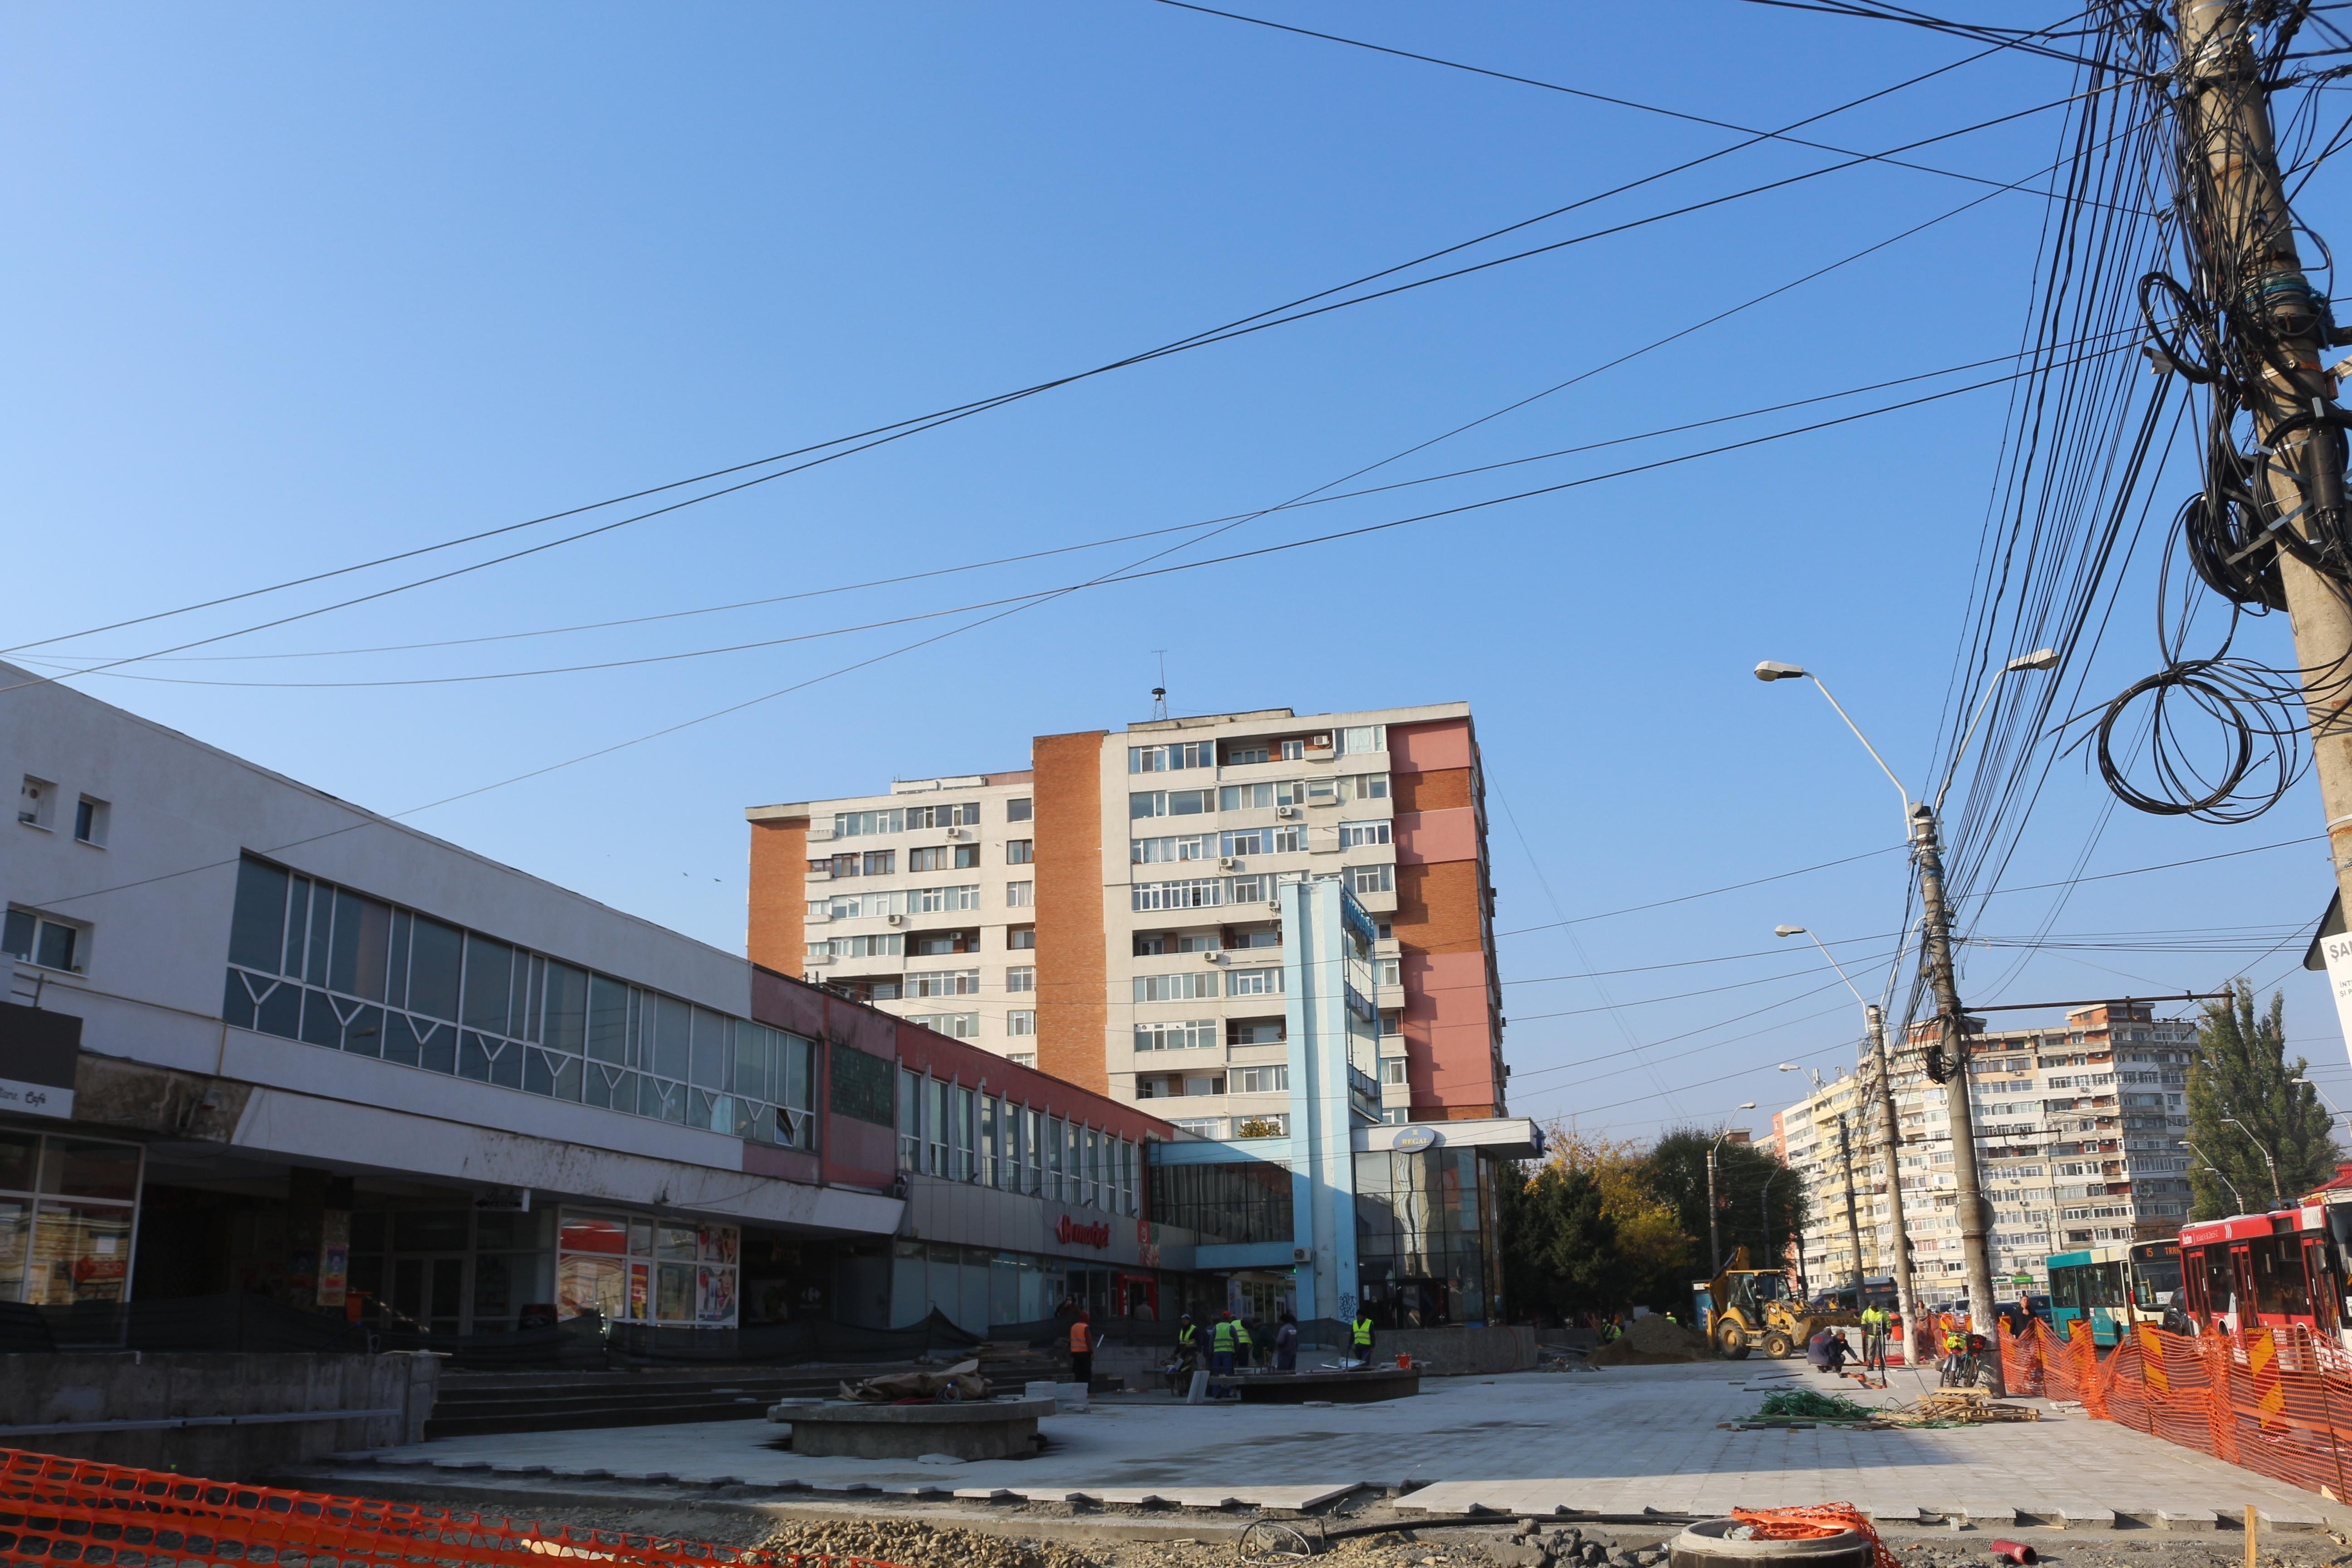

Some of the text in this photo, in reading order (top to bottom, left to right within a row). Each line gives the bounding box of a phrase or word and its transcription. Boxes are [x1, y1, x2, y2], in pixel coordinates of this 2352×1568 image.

[1402, 1137, 1429, 1146] REGAL
[1073, 1220, 1111, 1249] market
[2146, 1247, 2153, 1257] 15
